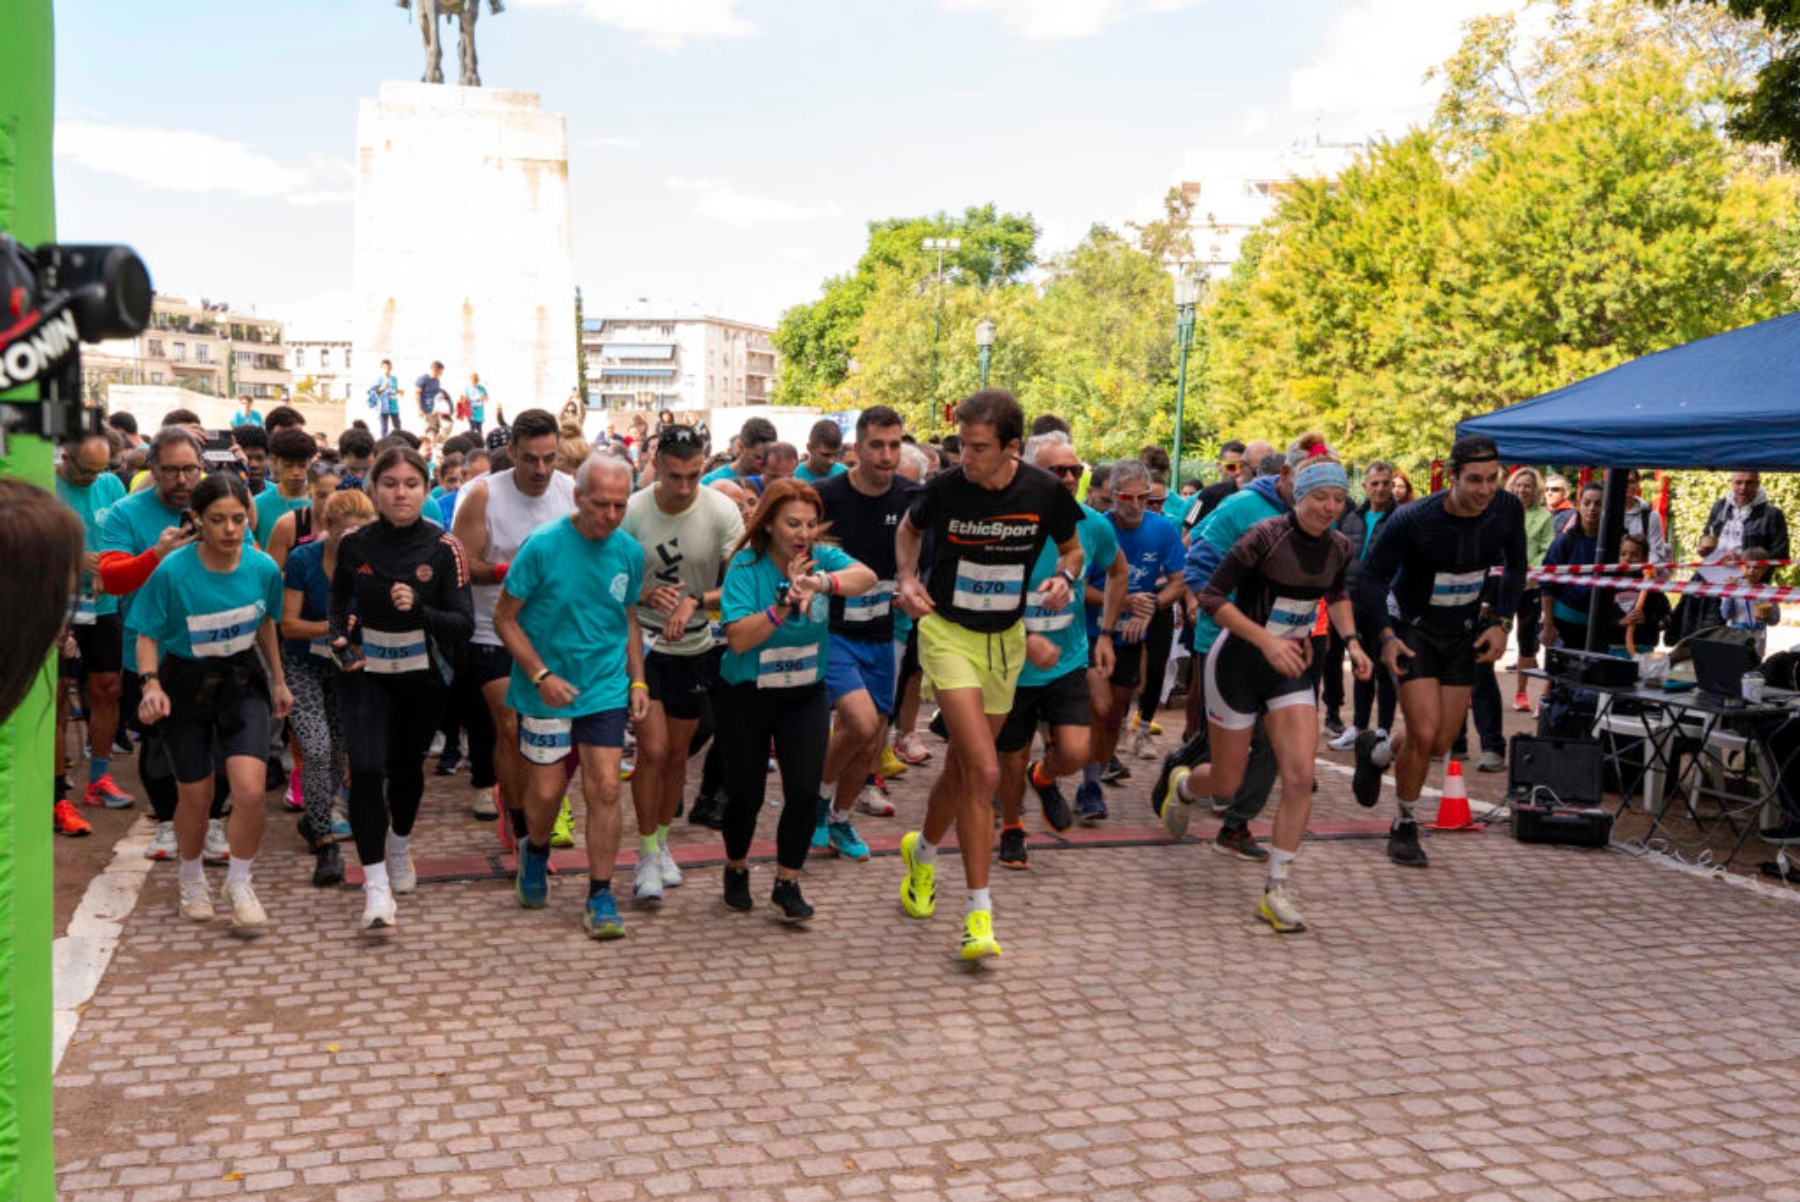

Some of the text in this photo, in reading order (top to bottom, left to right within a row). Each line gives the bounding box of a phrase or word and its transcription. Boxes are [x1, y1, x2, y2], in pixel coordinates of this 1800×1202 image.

[948, 518, 1039, 540] EthicSport
[973, 581, 1005, 595] 670
[209, 624, 240, 642] 749
[380, 646, 409, 659] 795
[774, 658, 804, 672] 596
